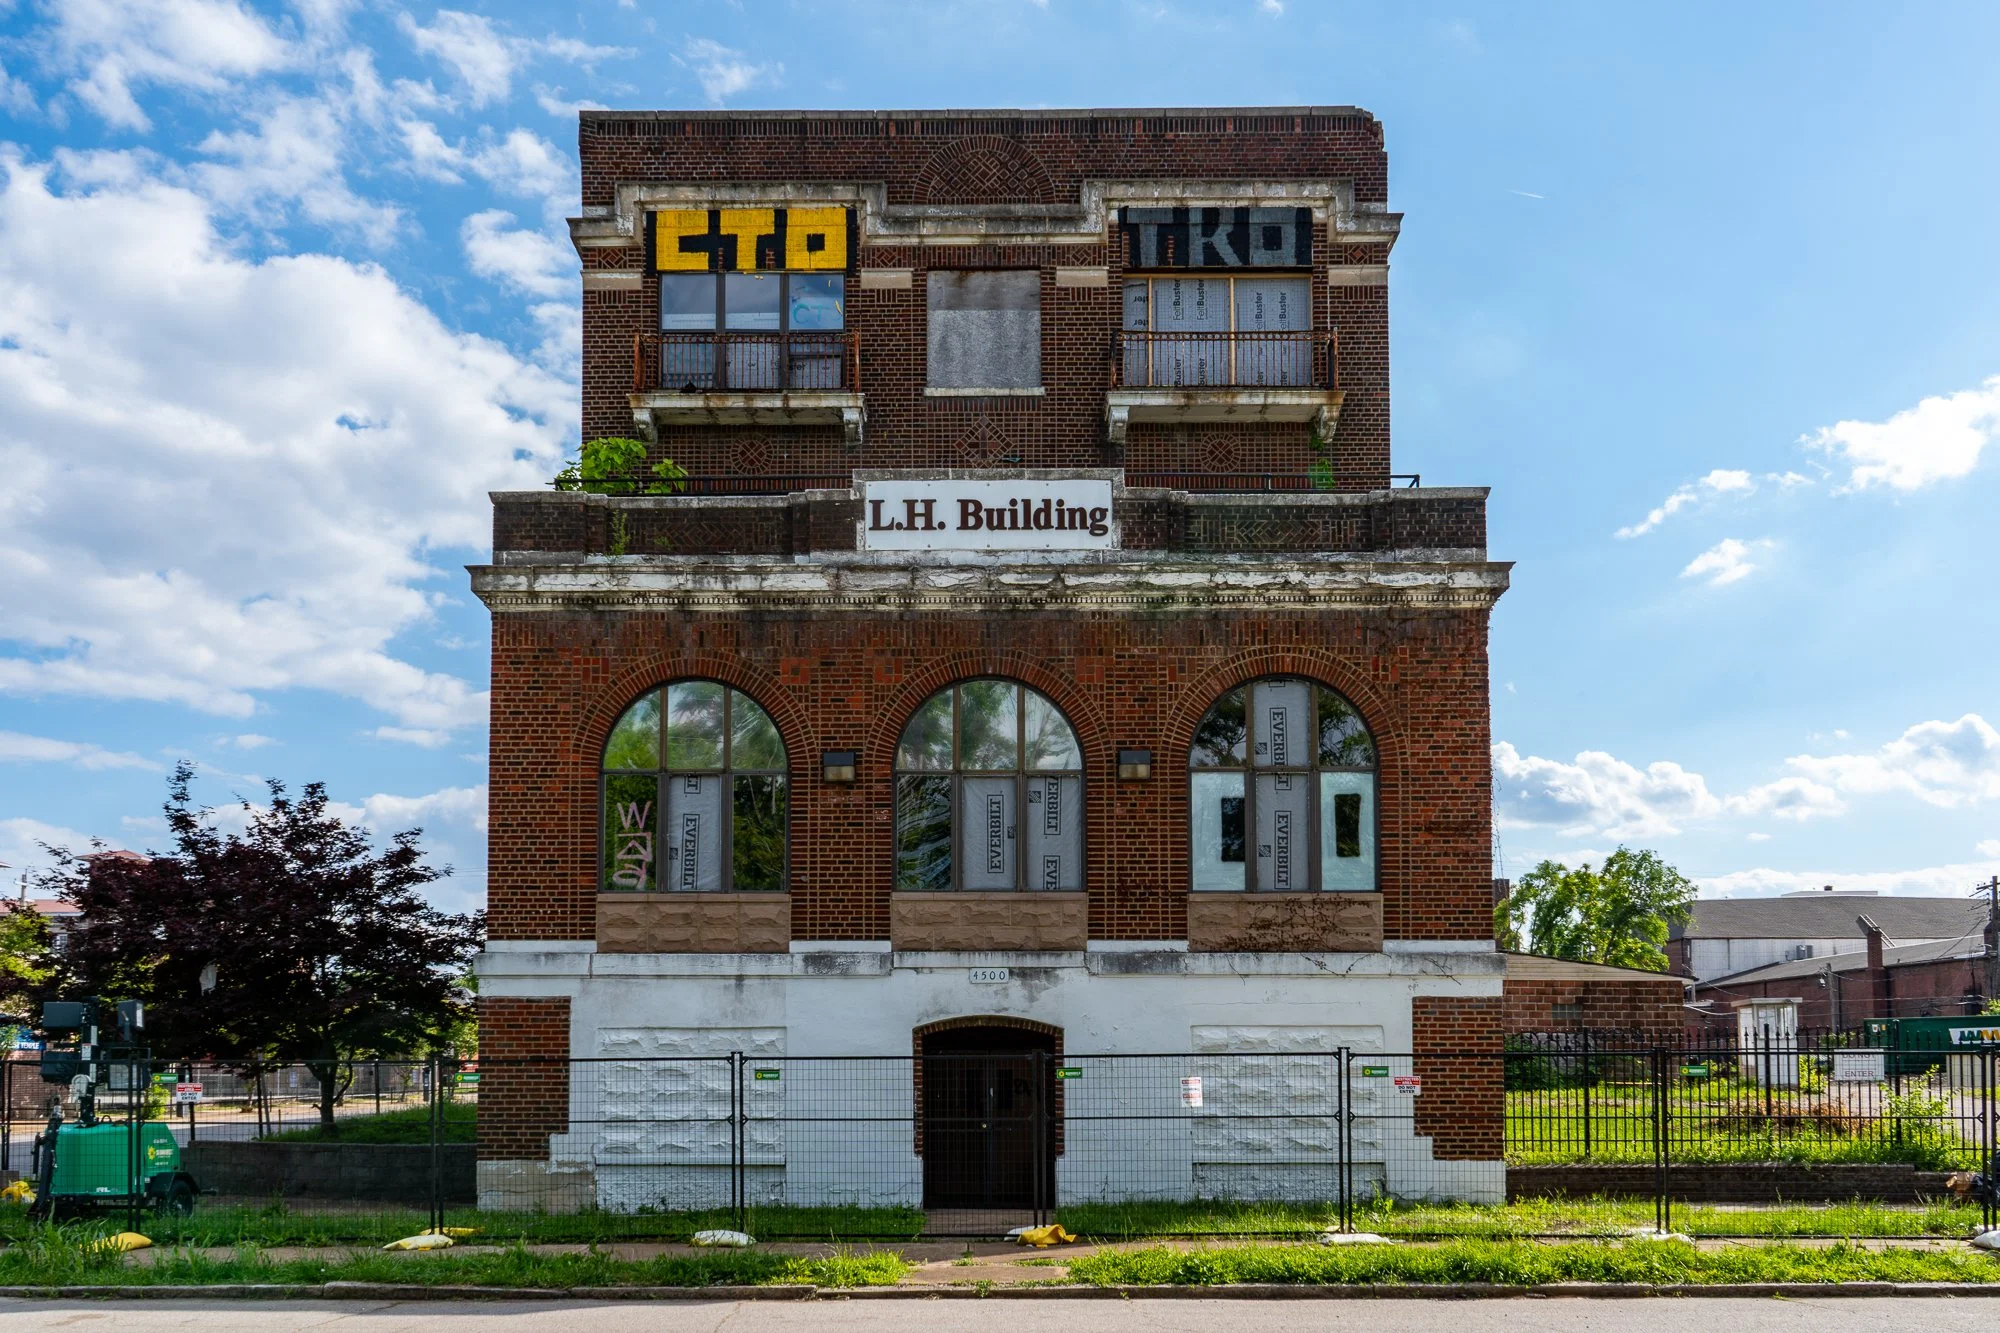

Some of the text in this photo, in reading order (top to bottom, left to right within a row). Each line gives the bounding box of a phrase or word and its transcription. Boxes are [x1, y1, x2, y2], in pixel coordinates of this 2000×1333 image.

[868, 498, 1109, 537] L.H. Building
[683, 817, 698, 889] EVERBILT
[990, 798, 1002, 871] EVERBILT
[1277, 814, 1289, 886] EVERBILT
[973, 970, 1006, 981] 4500
[1844, 1070, 1874, 1078] ENTER
